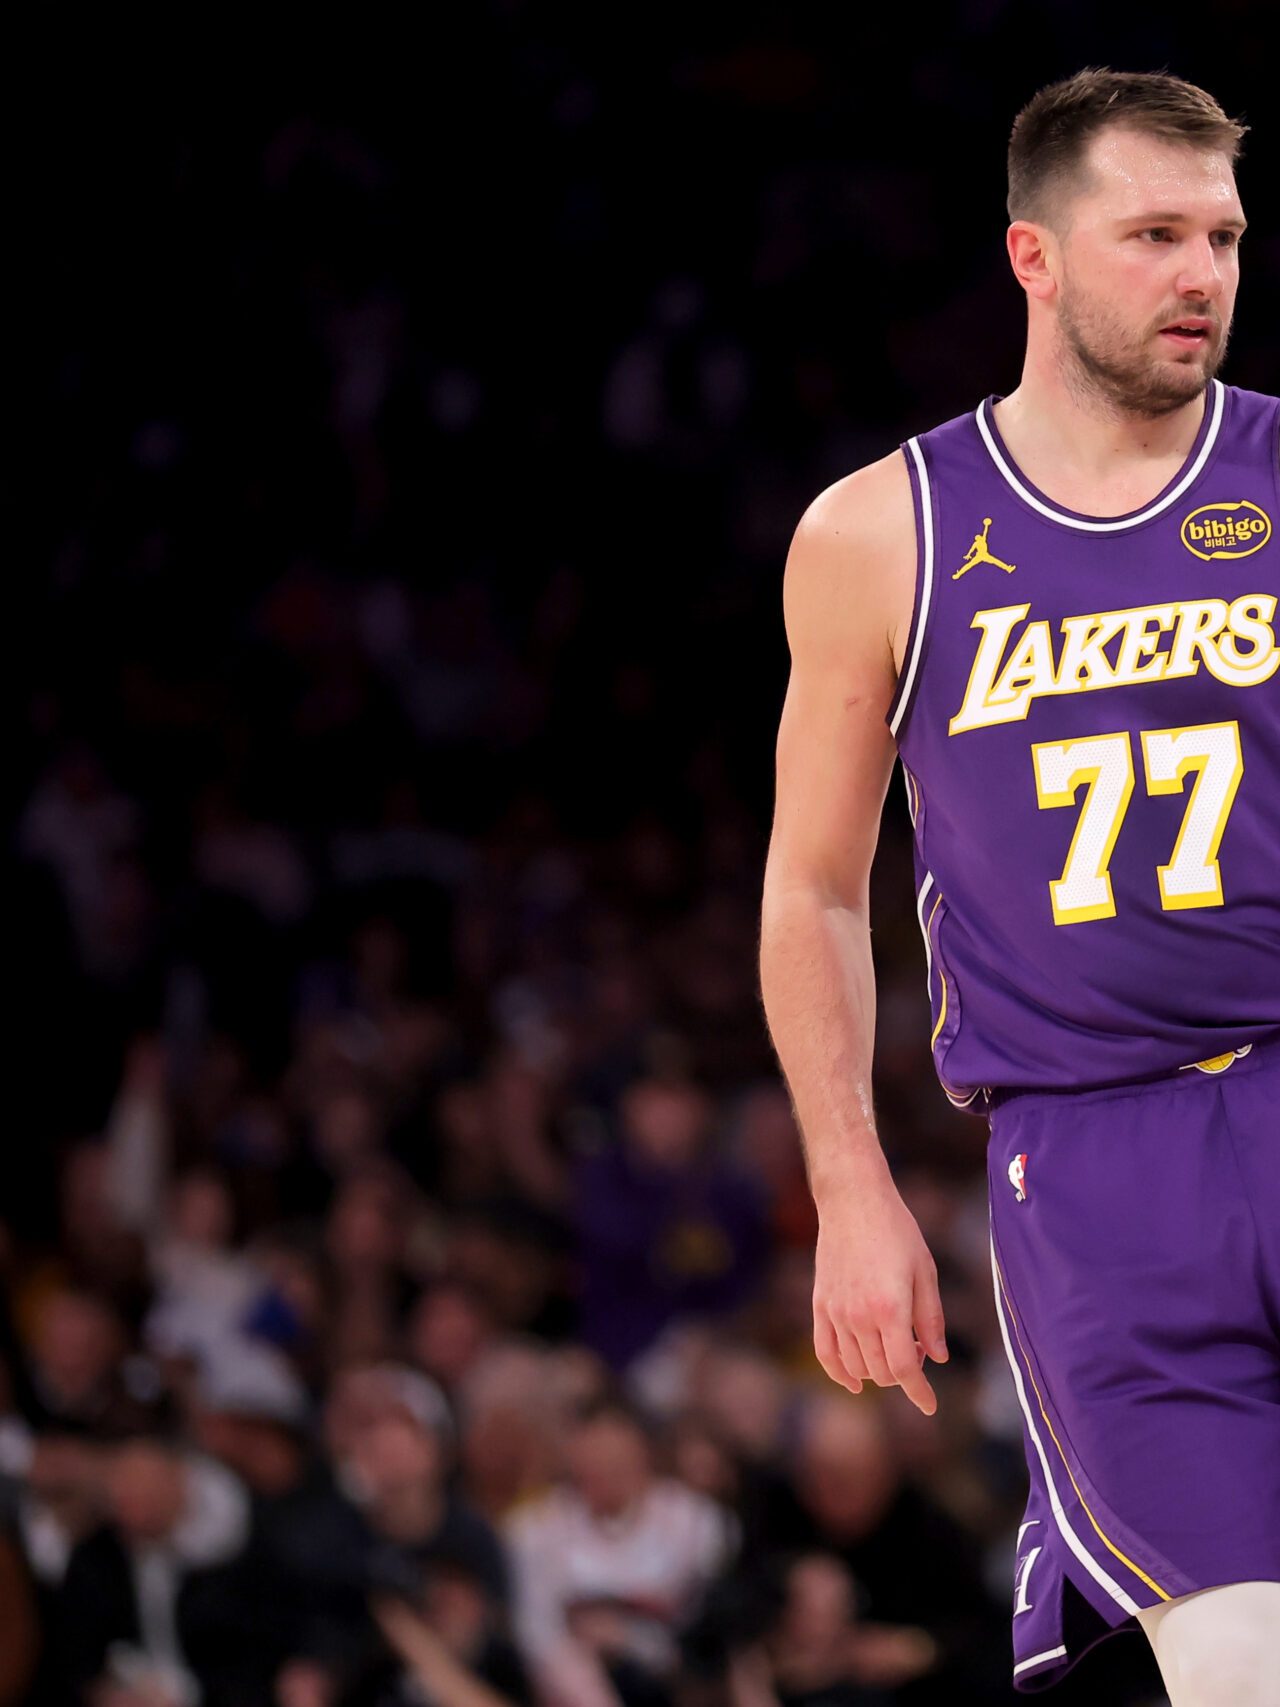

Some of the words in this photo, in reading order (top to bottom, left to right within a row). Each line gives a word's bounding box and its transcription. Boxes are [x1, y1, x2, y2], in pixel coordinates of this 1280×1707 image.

[1188, 517, 1265, 540] bibigo
[1204, 536, 1237, 548] 비비고
[1031, 720, 1244, 926] 77
